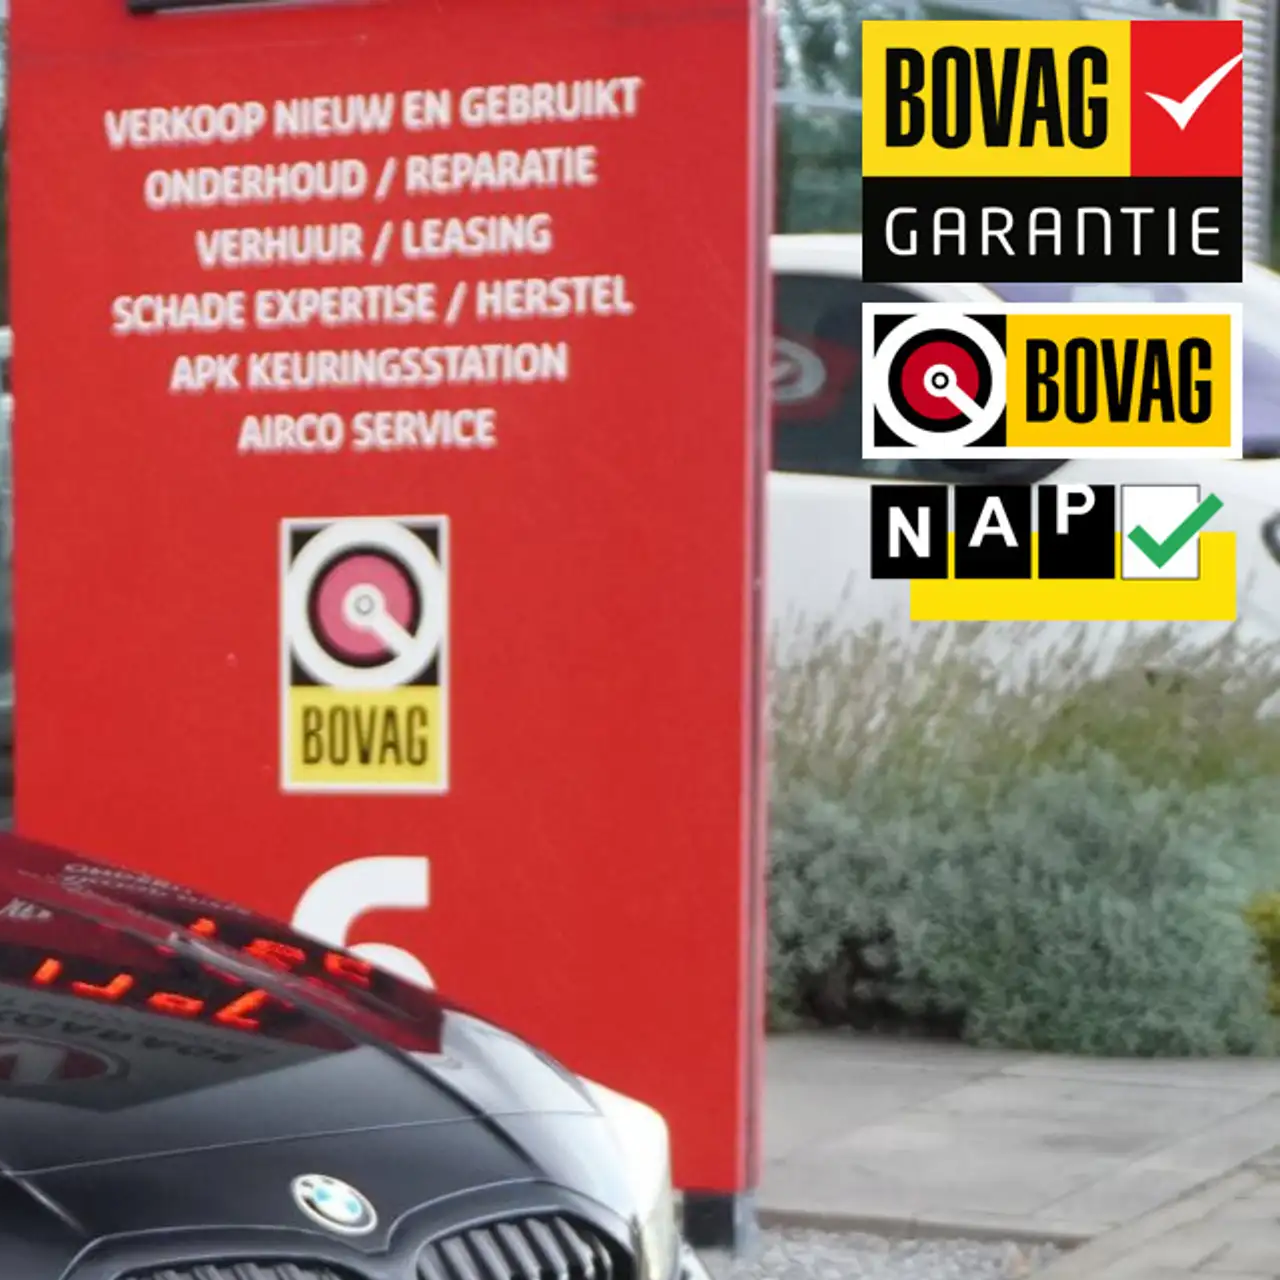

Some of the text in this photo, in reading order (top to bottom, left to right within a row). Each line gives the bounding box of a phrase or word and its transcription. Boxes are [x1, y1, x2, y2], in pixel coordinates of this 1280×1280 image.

[104, 76, 643, 148] VERKOOP NIEUW EN GEBRUIKT
[144, 145, 598, 210] ONDERHOUD / REPARATIE
[195, 213, 552, 269] VERHUUR / LEASING
[111, 274, 635, 334] SCHADE EXPERTISE / HERSTEL
[169, 342, 568, 394] APK KEURINGSSTATION
[237, 408, 496, 454] AIRCO SERVICE
[301, 704, 428, 766] BOVAG
